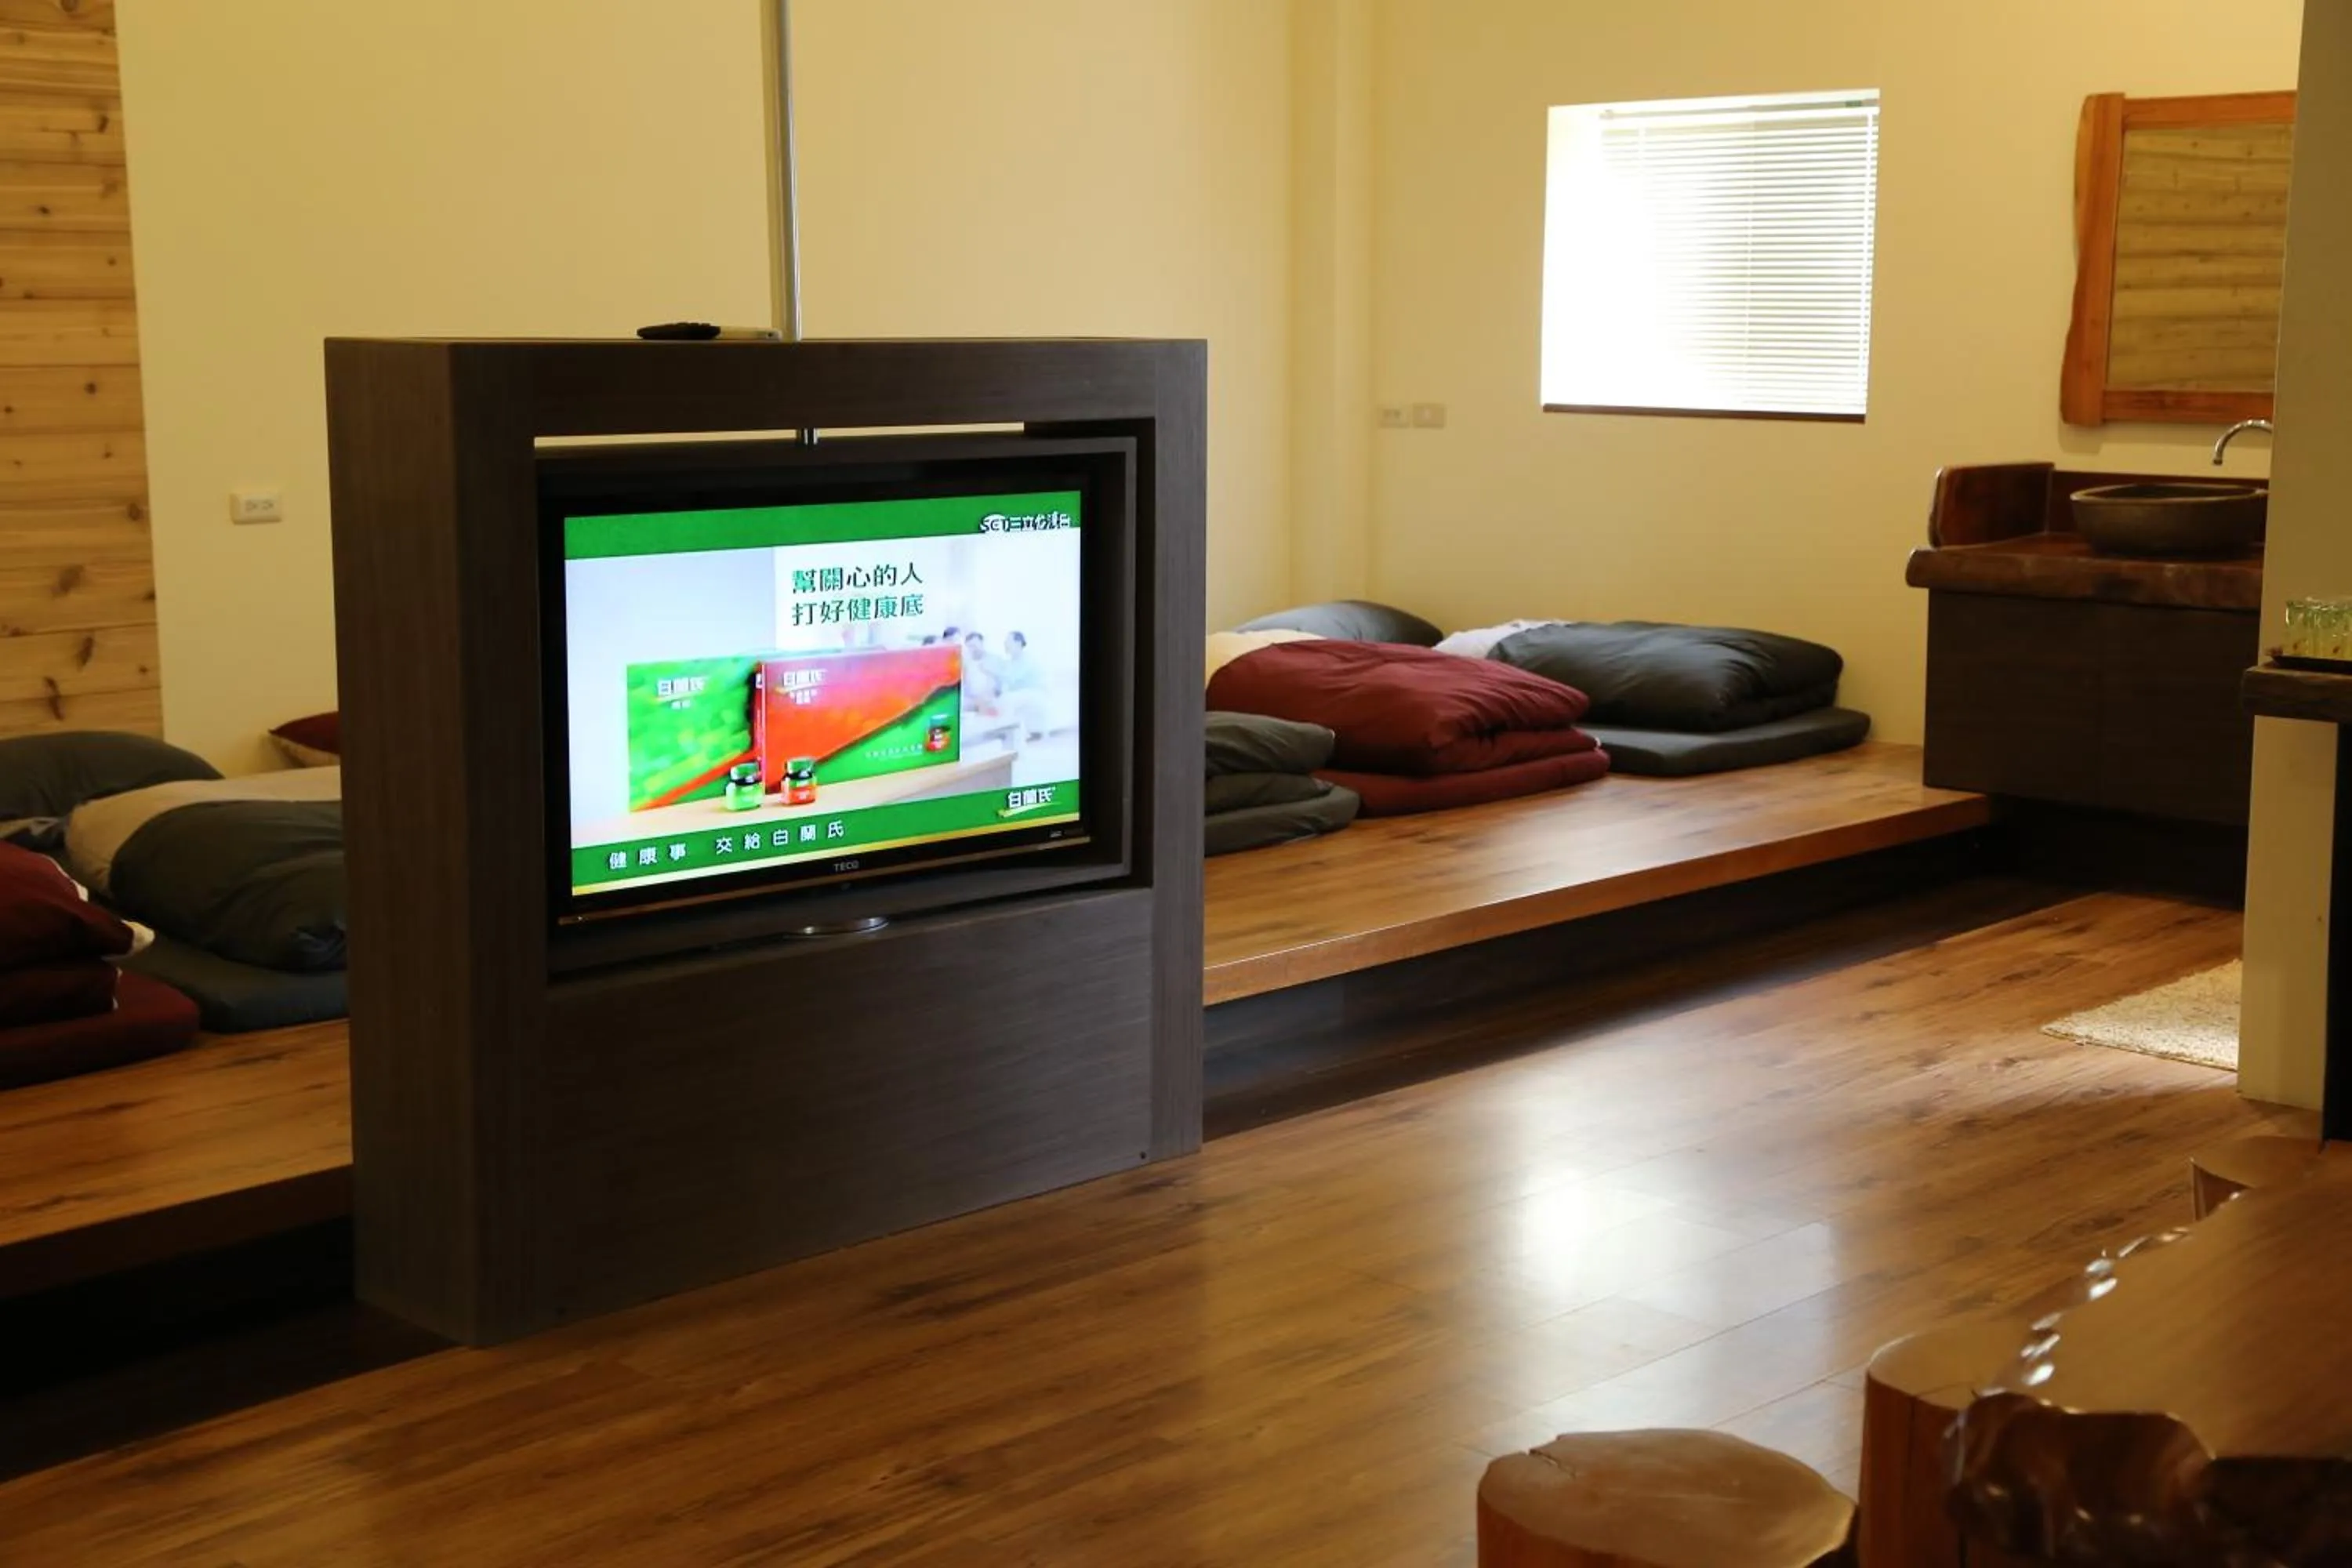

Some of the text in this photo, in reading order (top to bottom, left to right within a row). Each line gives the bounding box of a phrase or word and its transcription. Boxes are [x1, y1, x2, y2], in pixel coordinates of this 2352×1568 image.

[792, 561, 924, 594] 幫關心的人
[791, 593, 924, 626] 打好健康底
[715, 820, 844, 855] 交給白蘭氏
